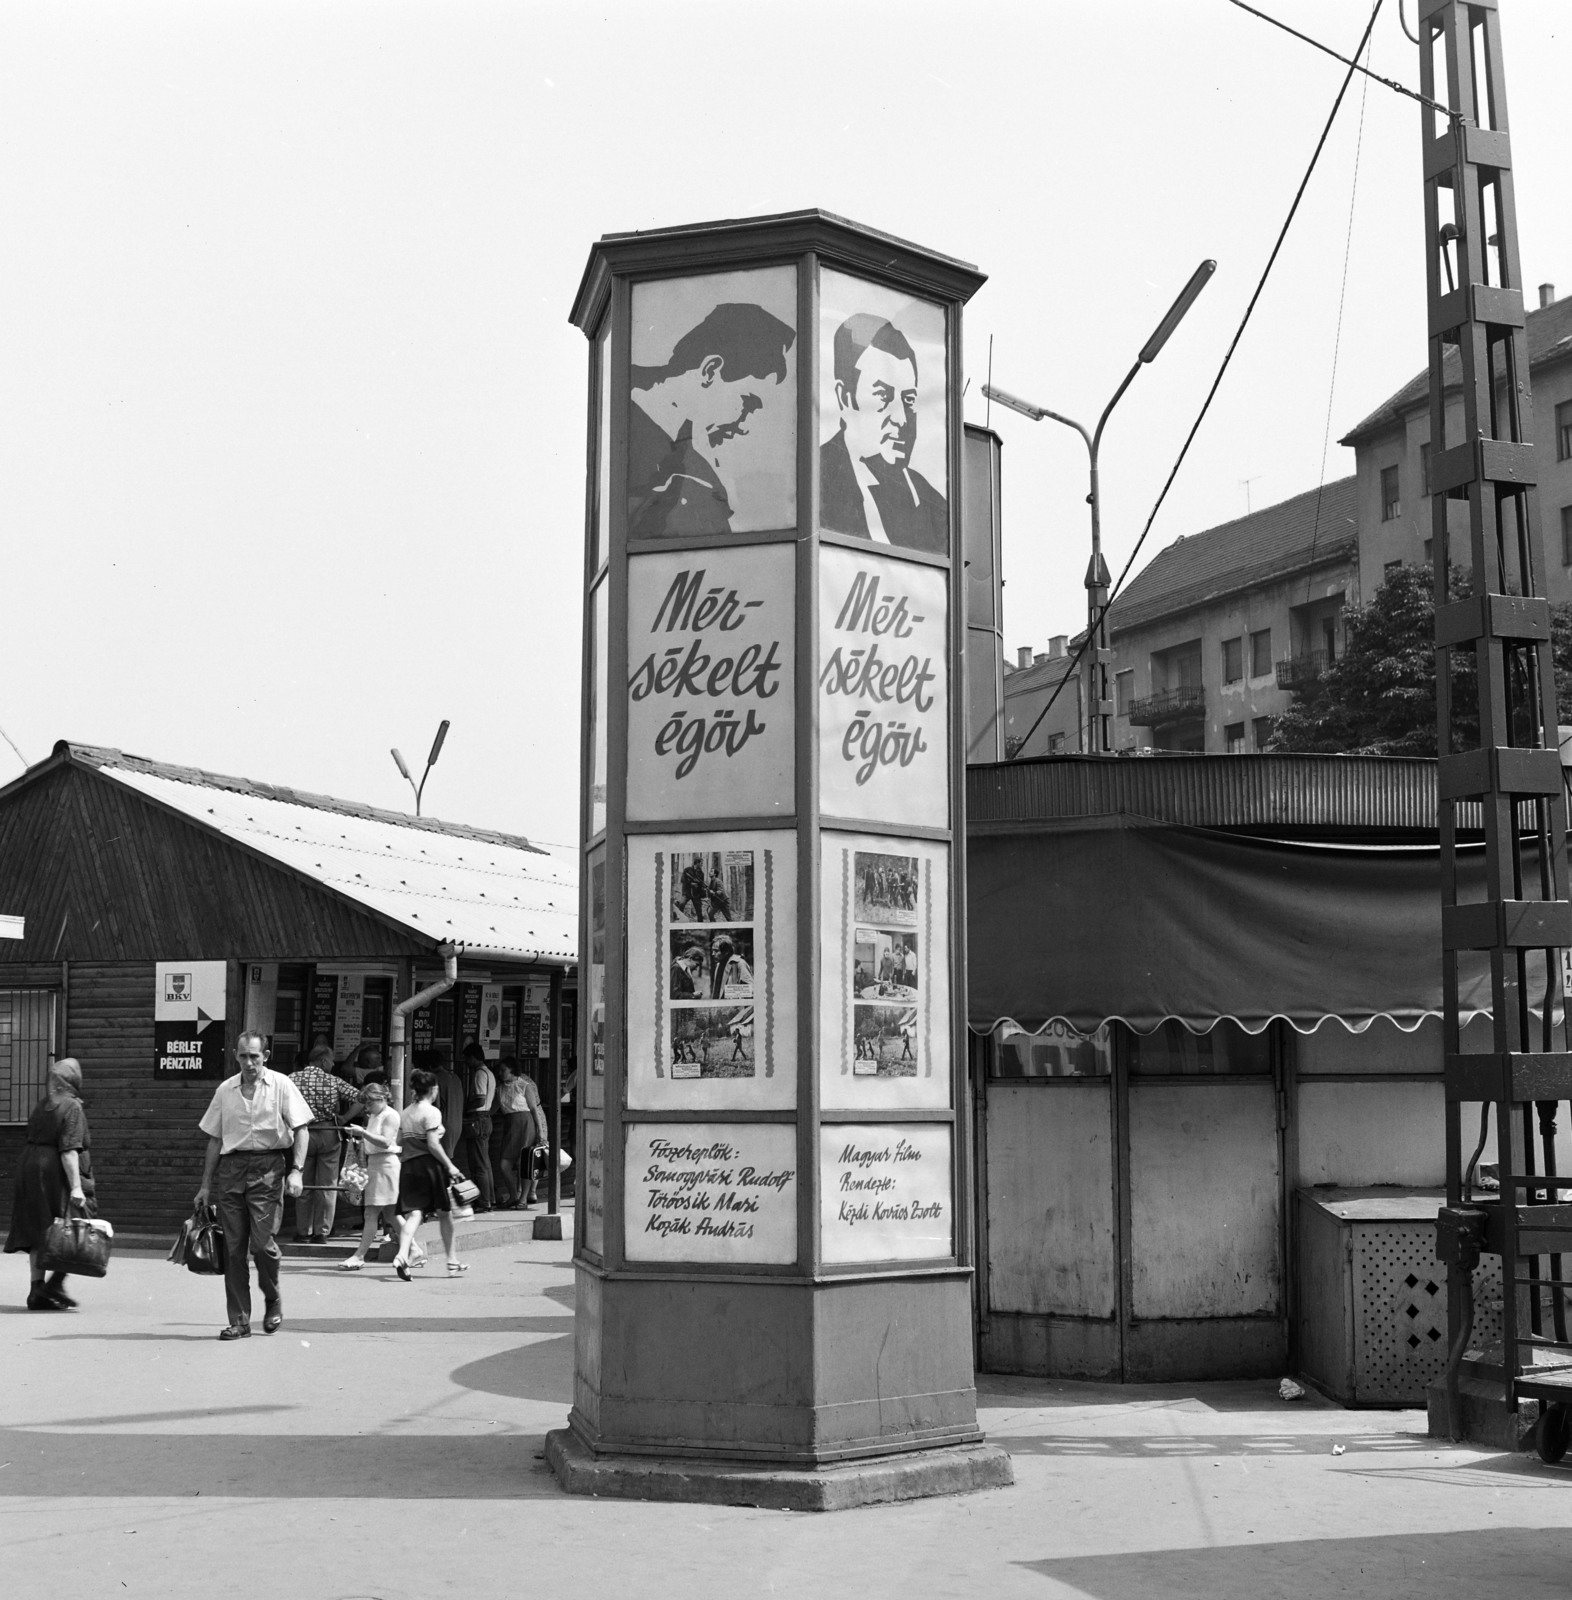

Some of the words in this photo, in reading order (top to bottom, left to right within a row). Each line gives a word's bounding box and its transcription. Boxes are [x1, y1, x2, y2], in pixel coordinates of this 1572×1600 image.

[628, 639, 781, 702] sékelt
[820, 643, 936, 712] sékelt
[655, 709, 766, 780] égöv
[842, 710, 927, 787] égöv
[166, 1040, 203, 1054] BÉRLET
[160, 1056, 203, 1070] PÉNZTÁR
[838, 1143, 891, 1168] Magyar
[643, 1164, 734, 1191] Somogyvári
[736, 1166, 795, 1193] Rudolf
[839, 1171, 896, 1196] Rendezte:
[713, 1191, 759, 1212] Mari
[838, 1200, 869, 1226] Kézdi
[872, 1201, 908, 1220] Kovács
[910, 1200, 942, 1220] Zsolt
[645, 1213, 691, 1238] Kozák
[694, 1217, 754, 1239] András
